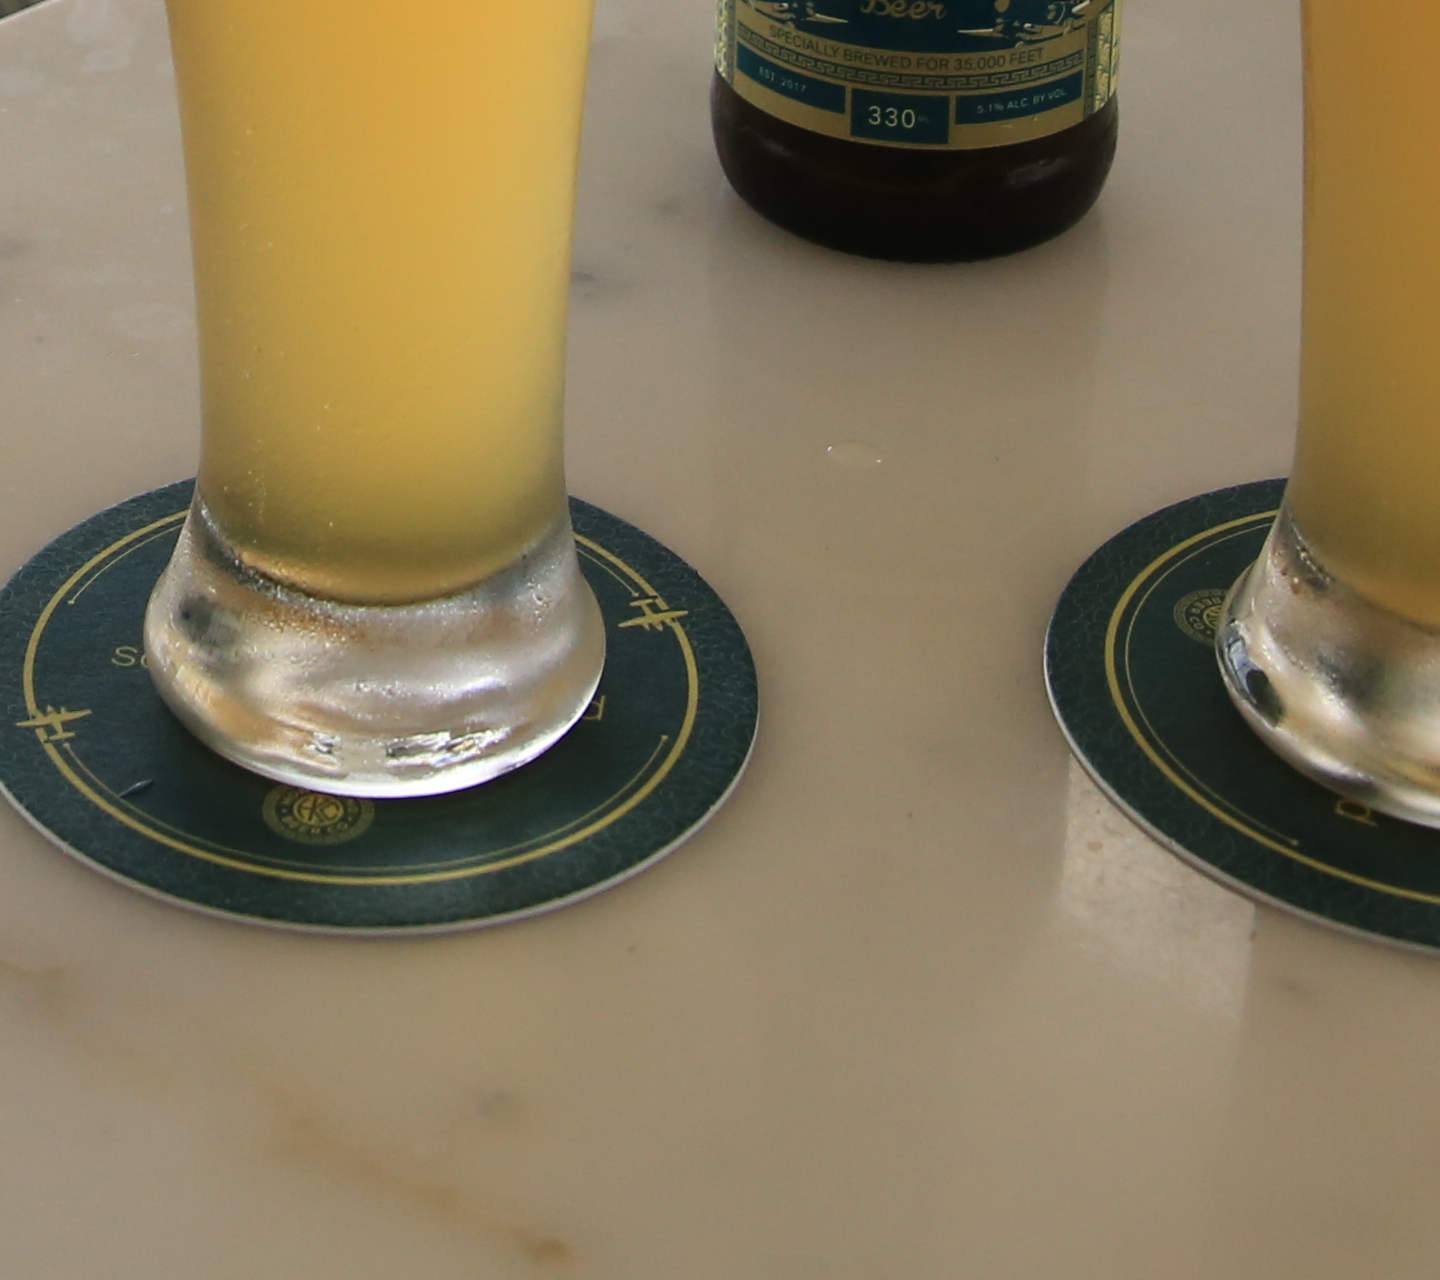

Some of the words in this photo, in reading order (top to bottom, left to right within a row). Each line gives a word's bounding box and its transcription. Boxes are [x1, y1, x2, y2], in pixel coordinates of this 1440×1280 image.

[770, 24, 840, 58] SPECIALLY
[843, 49, 913, 70] BREWED
[916, 56, 949, 71] FOR
[954, 55, 1006, 72] 35,000
[1009, 47, 1045, 65] FEET
[781, 77, 807, 93] 2017
[1032, 92, 1047, 105] BY
[868, 104, 916, 130] 330
